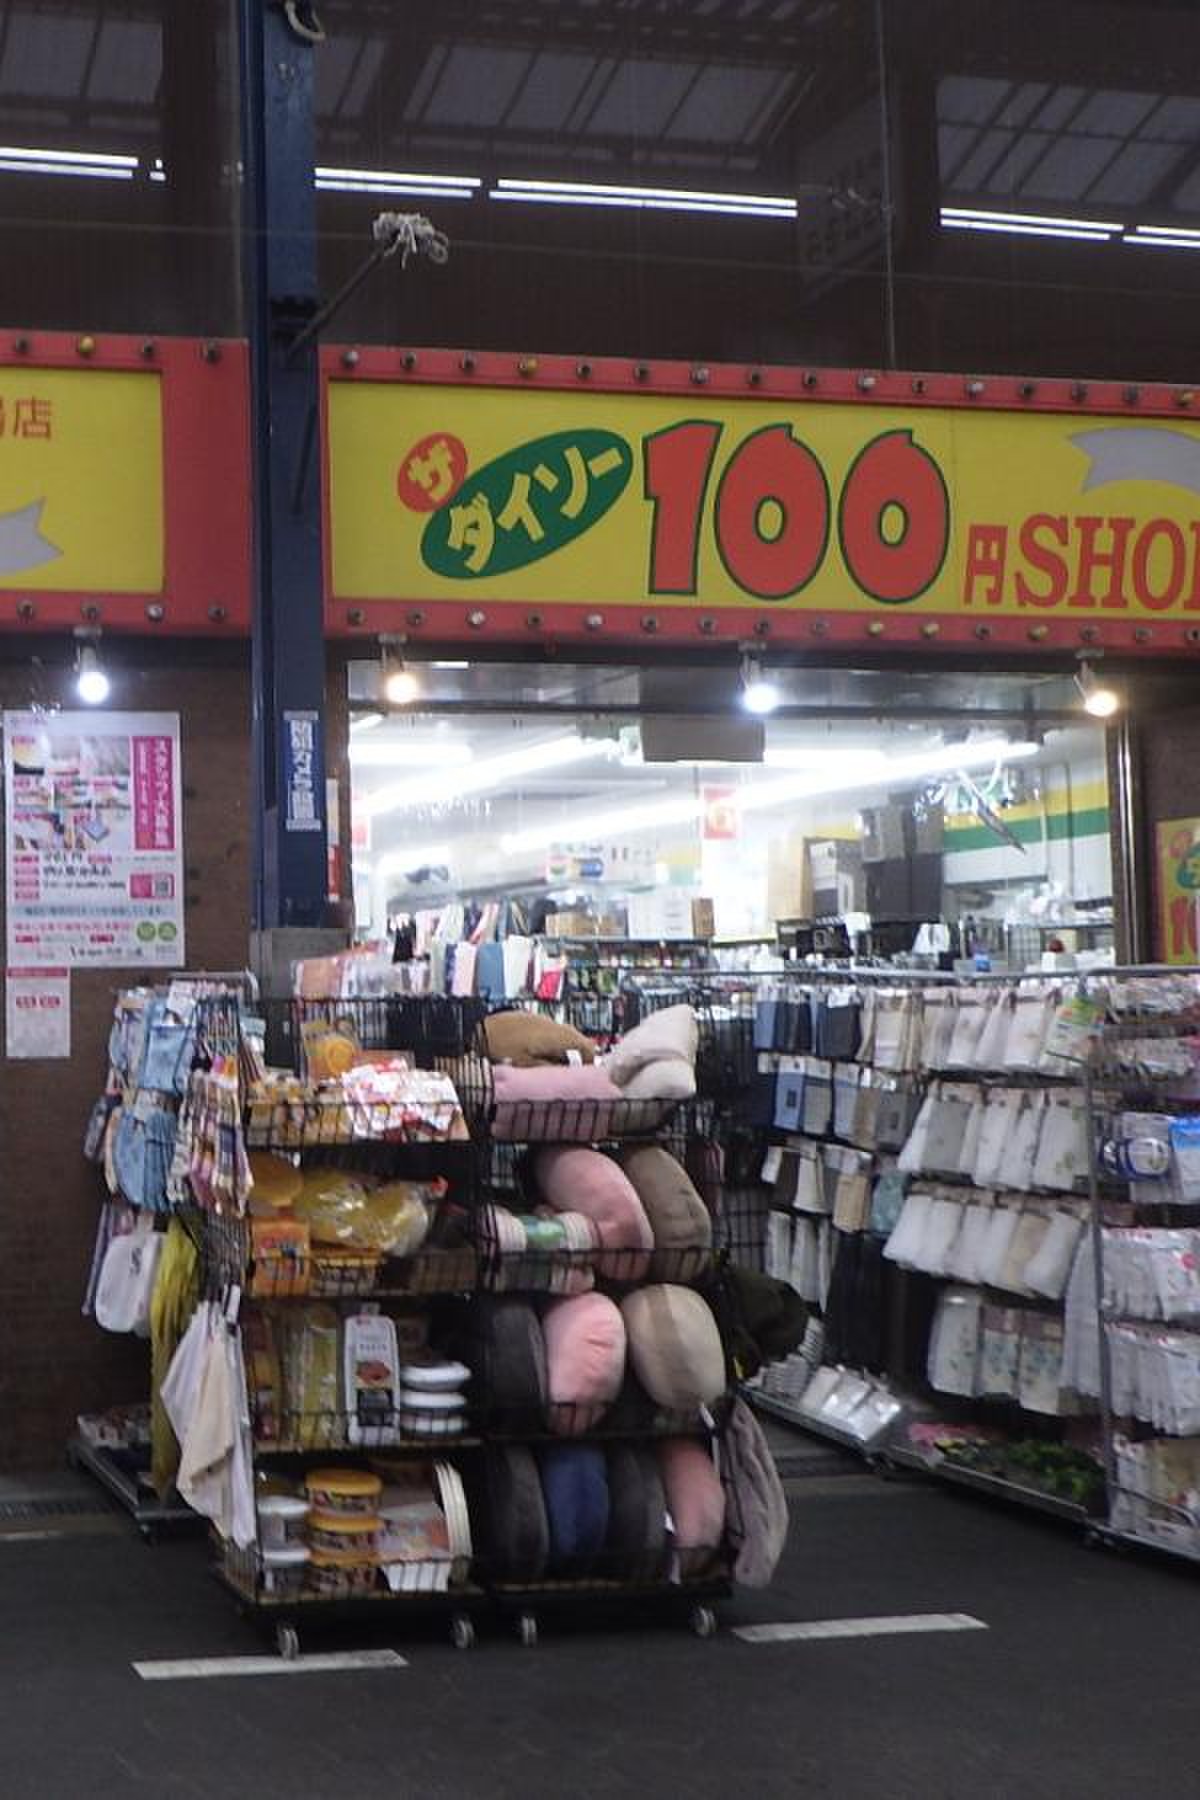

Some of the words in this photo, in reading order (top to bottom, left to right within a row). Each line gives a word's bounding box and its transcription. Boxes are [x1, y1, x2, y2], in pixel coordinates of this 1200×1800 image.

[447, 445, 624, 573] ダイソー
[1013, 513, 1200, 611] SHO
